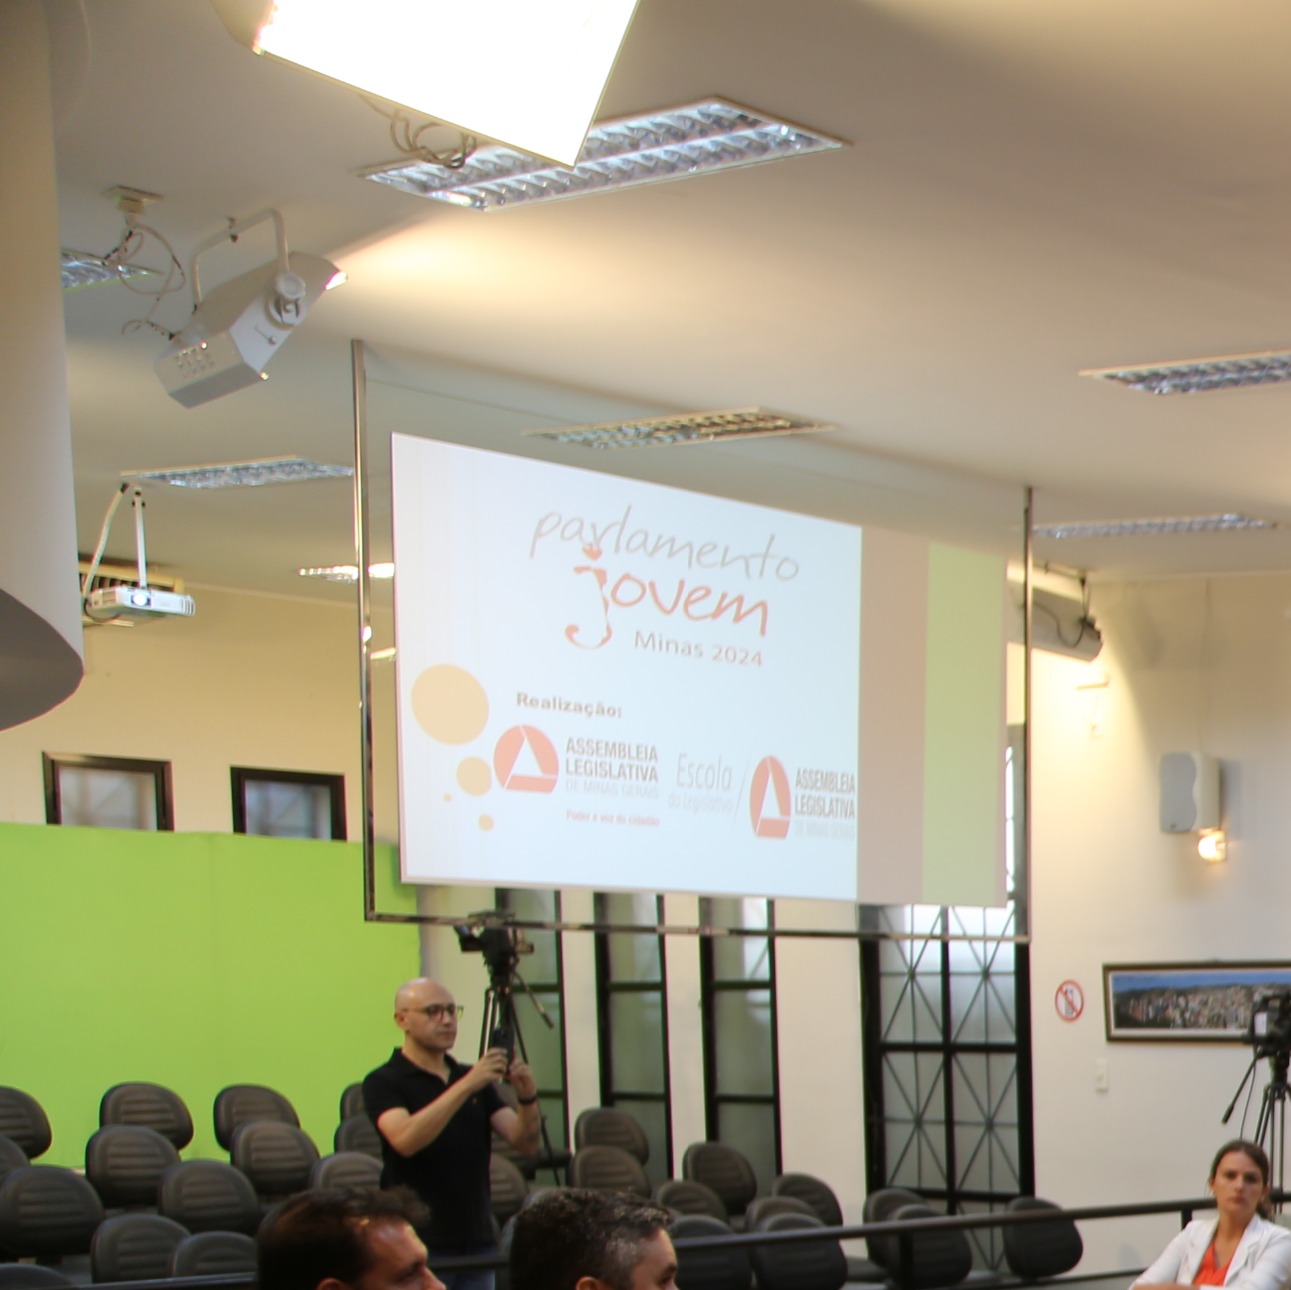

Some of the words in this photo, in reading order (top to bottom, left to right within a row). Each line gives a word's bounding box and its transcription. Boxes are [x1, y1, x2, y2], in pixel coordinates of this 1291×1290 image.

[529, 504, 799, 582] parlamento
[564, 542, 768, 650] jovem
[634, 629, 703, 660] Minas
[711, 643, 763, 668] 2024
[516, 691, 622, 718] Realização:
[565, 736, 658, 763] ASSEMBLEIA
[565, 757, 658, 783] LEGISLATIVA
[676, 753, 732, 792] Escola
[795, 767, 855, 795] ASSEMBLEIA
[795, 792, 855, 820] LEGISLATIVA
